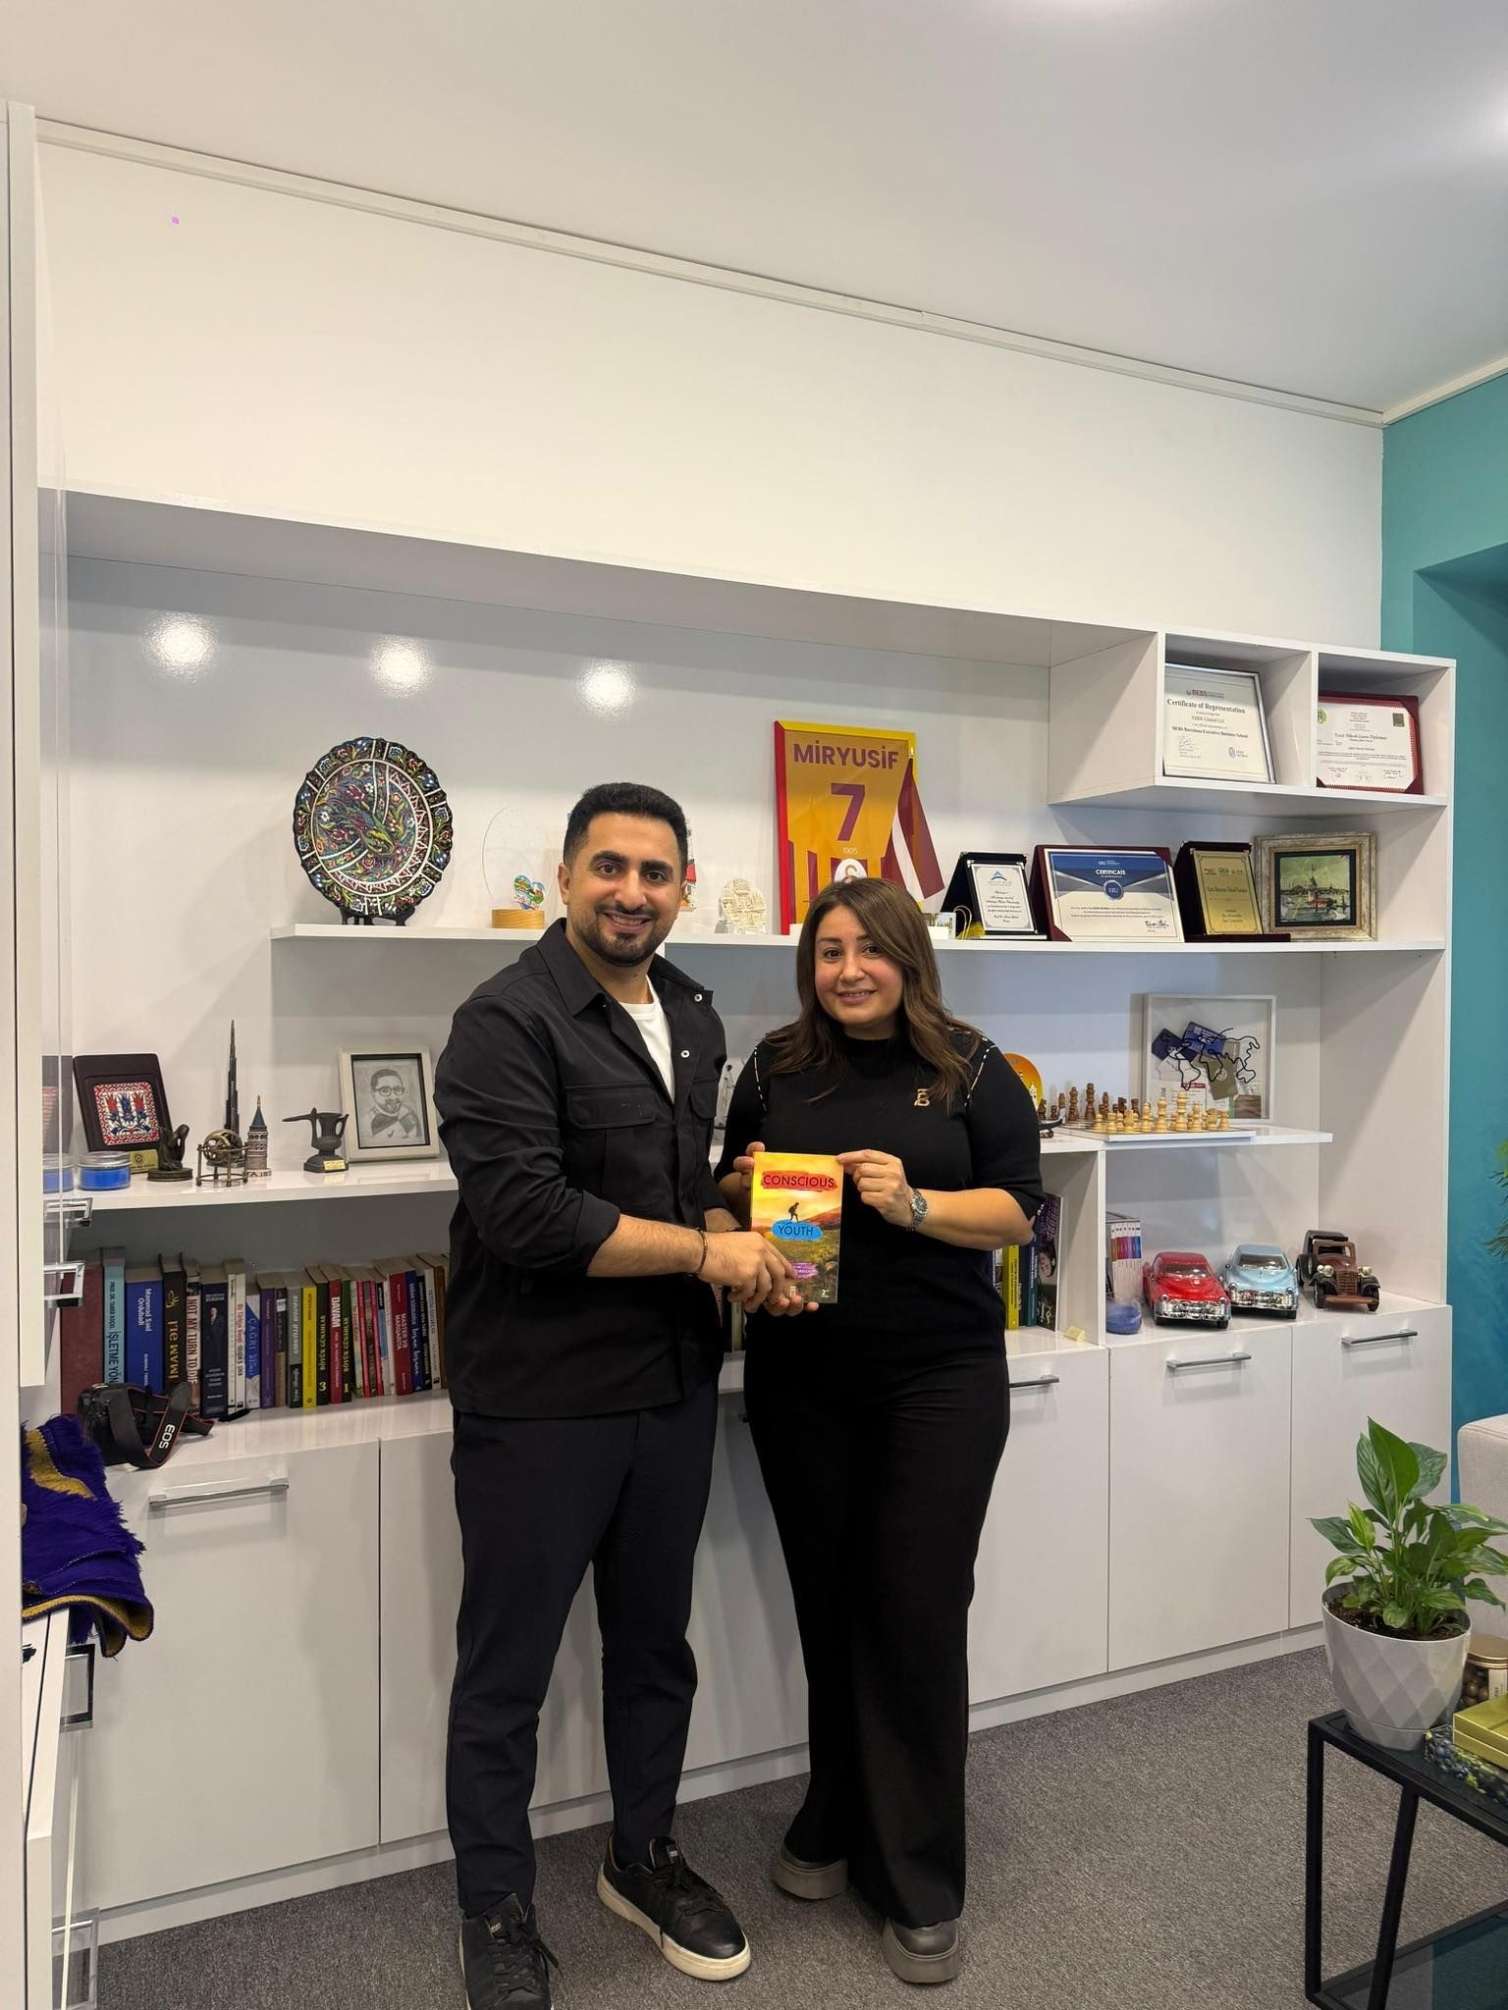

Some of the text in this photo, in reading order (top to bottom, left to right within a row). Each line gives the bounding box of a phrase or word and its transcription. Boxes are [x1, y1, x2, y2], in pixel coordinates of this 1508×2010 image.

[1166, 698, 1197, 709] Certificate
[1204, 703, 1246, 714] Representation
[793, 740, 899, 769] MİRYUSİF
[830, 782, 865, 841] 7
[763, 1175, 834, 1187] CONSCIOUS
[777, 1223, 814, 1237] YOUTH
[187, 1298, 198, 1315] NOT
[331, 1296, 341, 1328] DAVAM
[187, 1317, 198, 1329] MY
[106, 1330, 122, 1366] İŞLETME
[187, 1333, 198, 1355] TURN
[187, 1357, 198, 1368] TO
[158, 1424, 176, 1449] EOS
